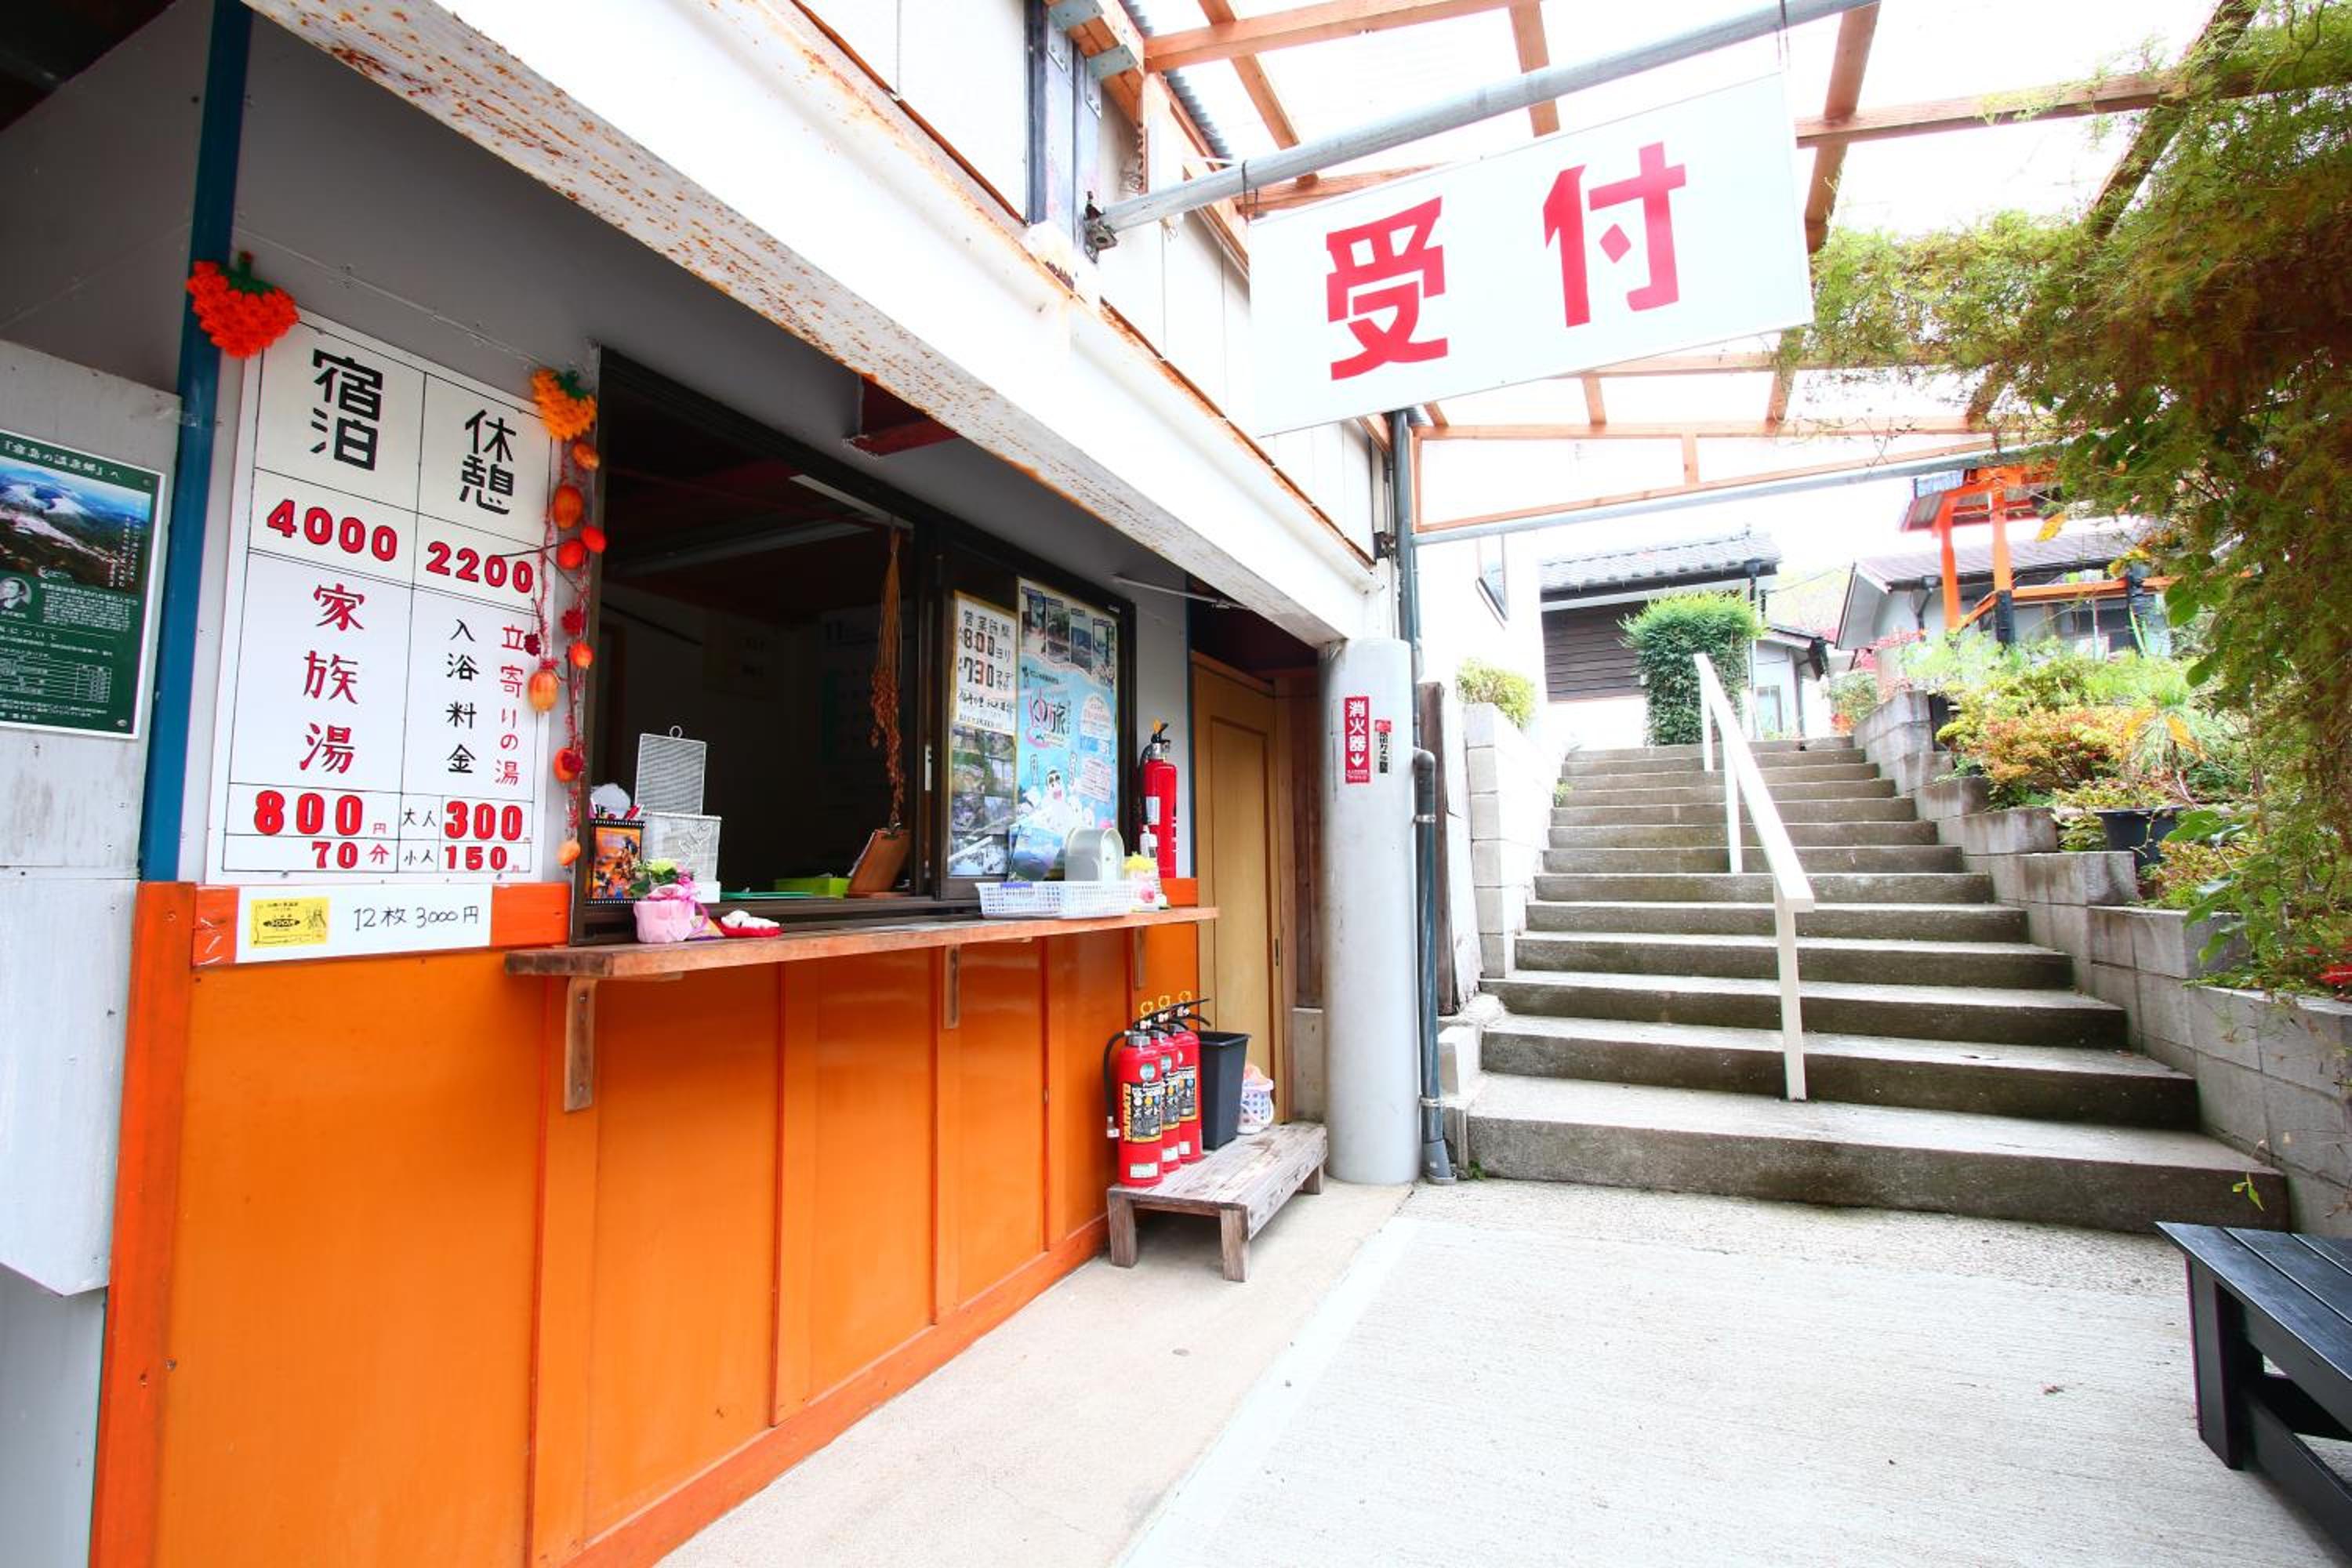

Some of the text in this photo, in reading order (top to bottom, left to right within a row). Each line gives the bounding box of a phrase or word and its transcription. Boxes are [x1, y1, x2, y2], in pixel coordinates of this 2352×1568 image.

[1327, 141, 1686, 381] 受付
[310, 348, 384, 471] 宿泊
[459, 408, 517, 516] 休憩
[267, 499, 398, 563] 4000
[426, 540, 535, 594] 2200
[299, 583, 365, 775] 家族湯
[445, 618, 481, 775] 入浴料金
[494, 624, 524, 786] 立寄りの湯
[1349, 700, 1366, 752] 消火器
[254, 789, 387, 836] 800 円
[403, 800, 524, 841] 大人 300
[311, 841, 390, 869] 70 分
[404, 849, 434, 864] 小人
[445, 844, 508, 871] 150
[354, 906, 481, 931] 12枚 3000円
